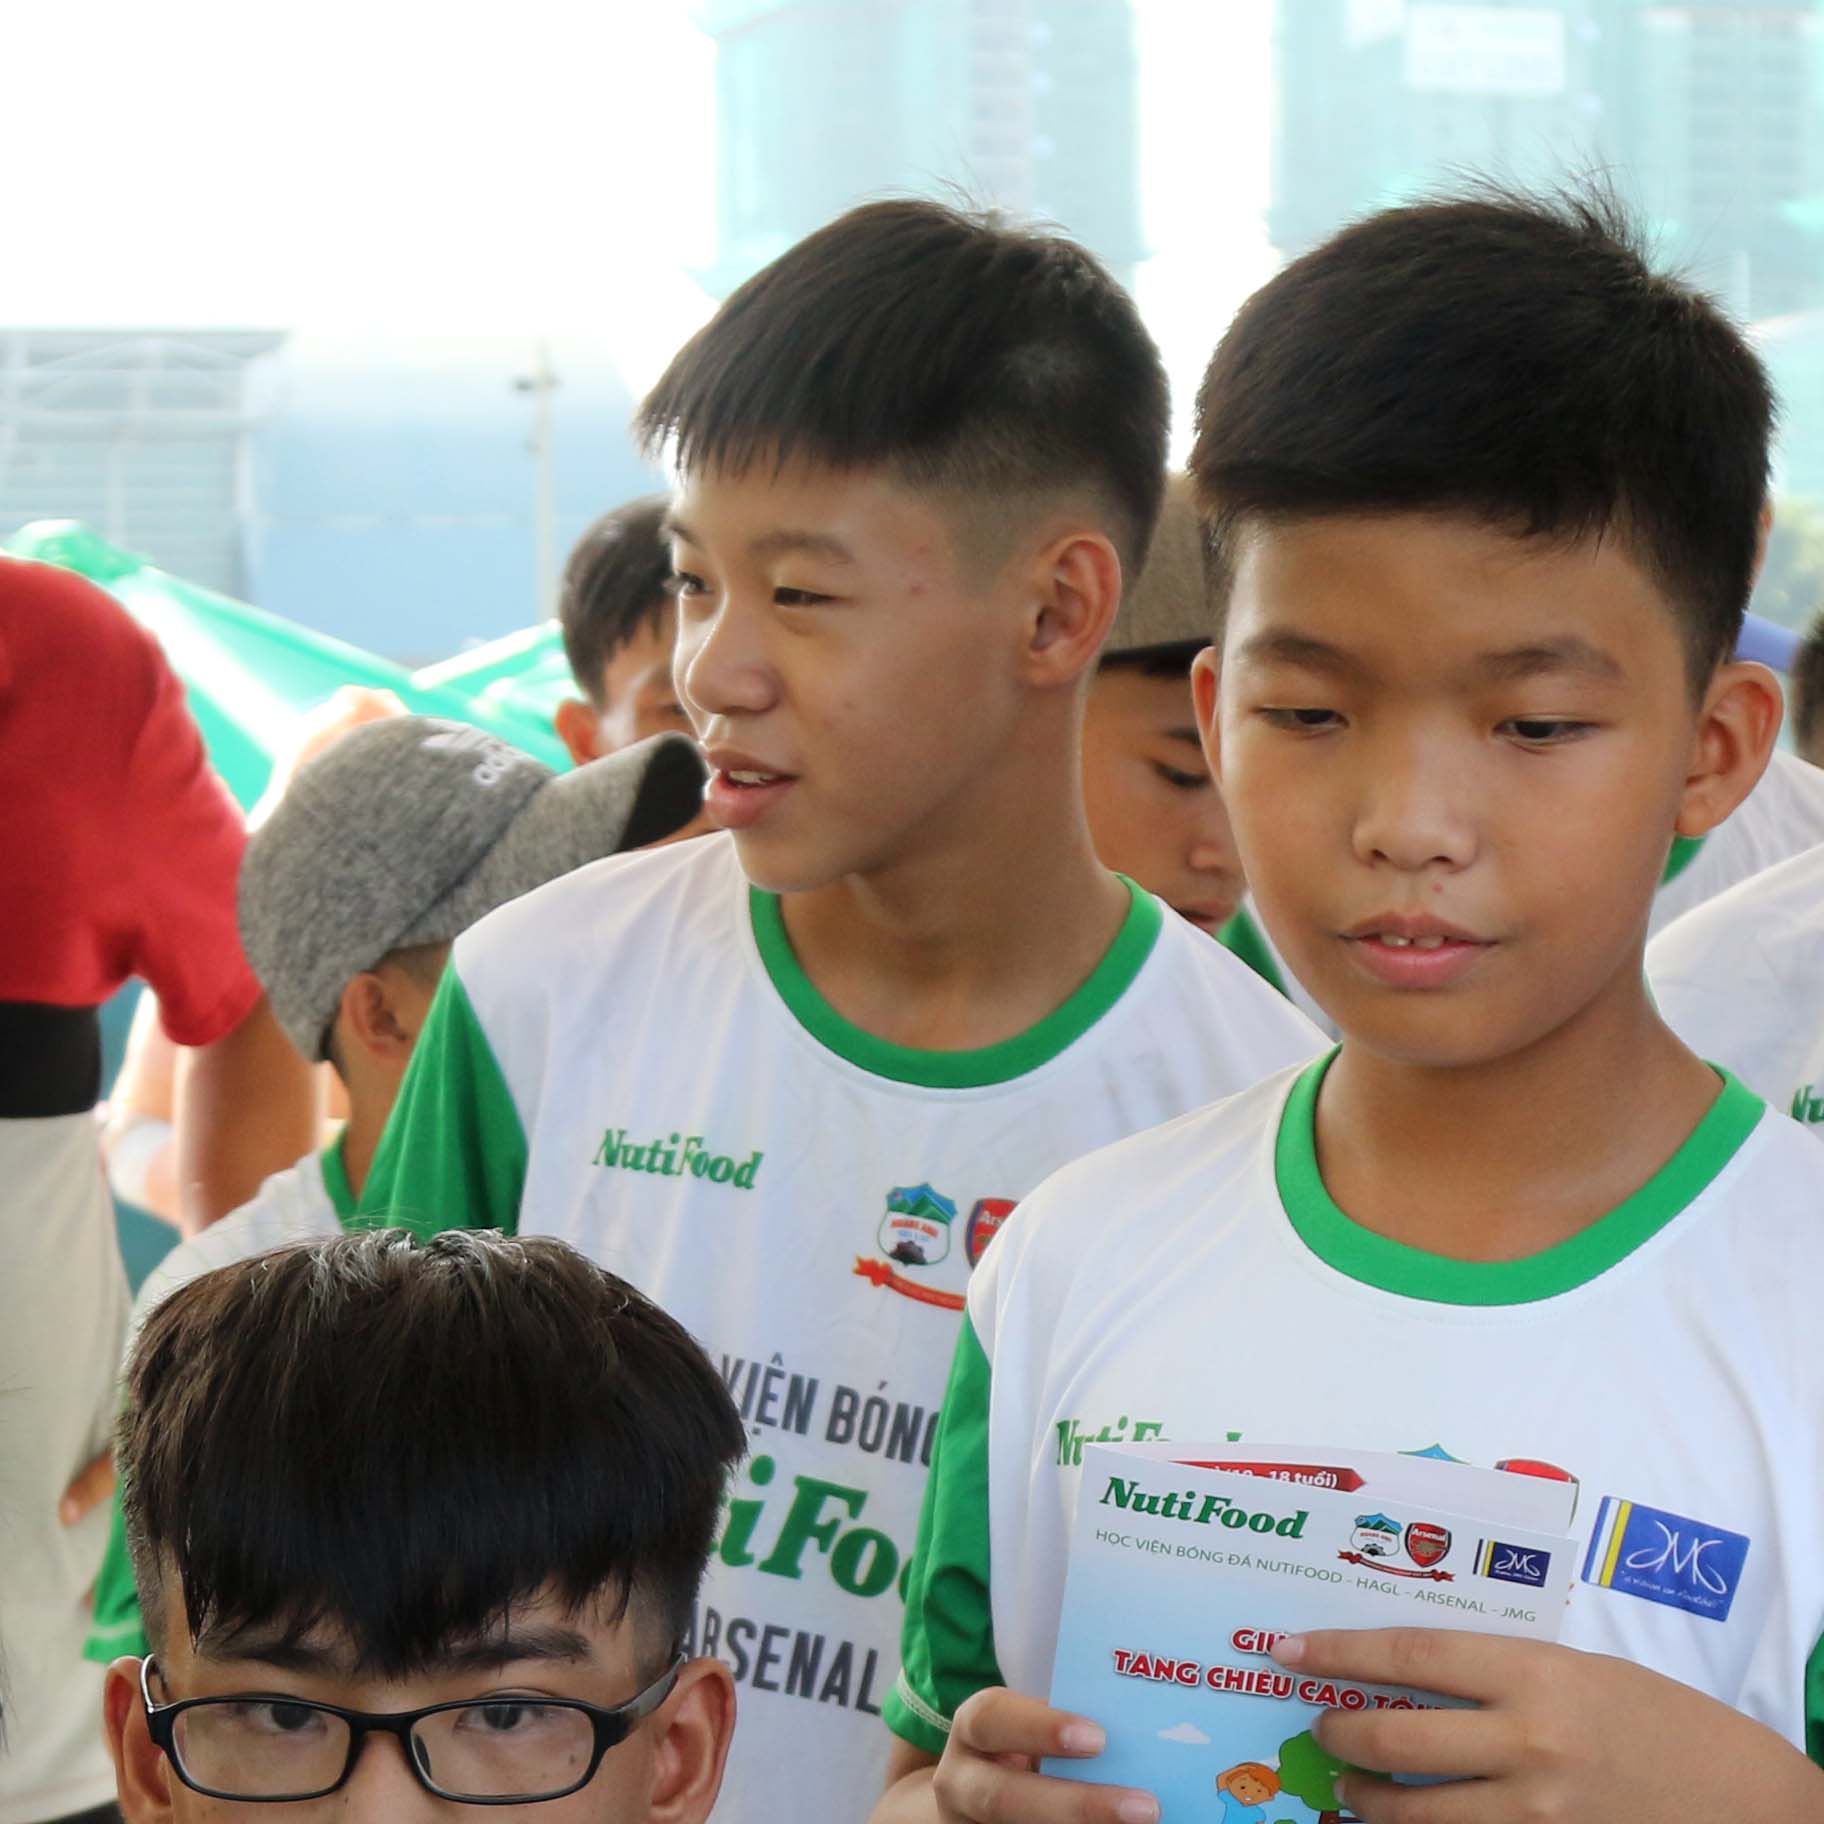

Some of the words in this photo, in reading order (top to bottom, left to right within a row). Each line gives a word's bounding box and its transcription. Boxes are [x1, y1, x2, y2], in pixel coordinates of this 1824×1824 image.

[593, 1129, 764, 1191] NutiFood
[1099, 1476, 1310, 1541] NutiFood
[1411, 1527, 1446, 1541] Arsenal
[1095, 1528, 1132, 1552] HỌC
[1134, 1534, 1172, 1557] VIỆN
[1176, 1541, 1224, 1566] BÓNG
[1227, 1549, 1252, 1569] ĐÁ
[1256, 1556, 1343, 1585] NUTIFOOD
[1356, 1576, 1401, 1597] HAGL
[1414, 1589, 1488, 1615] ARSENAL
[1501, 1607, 1537, 1623] JMG
[1298, 1680, 1368, 1711] CAO
